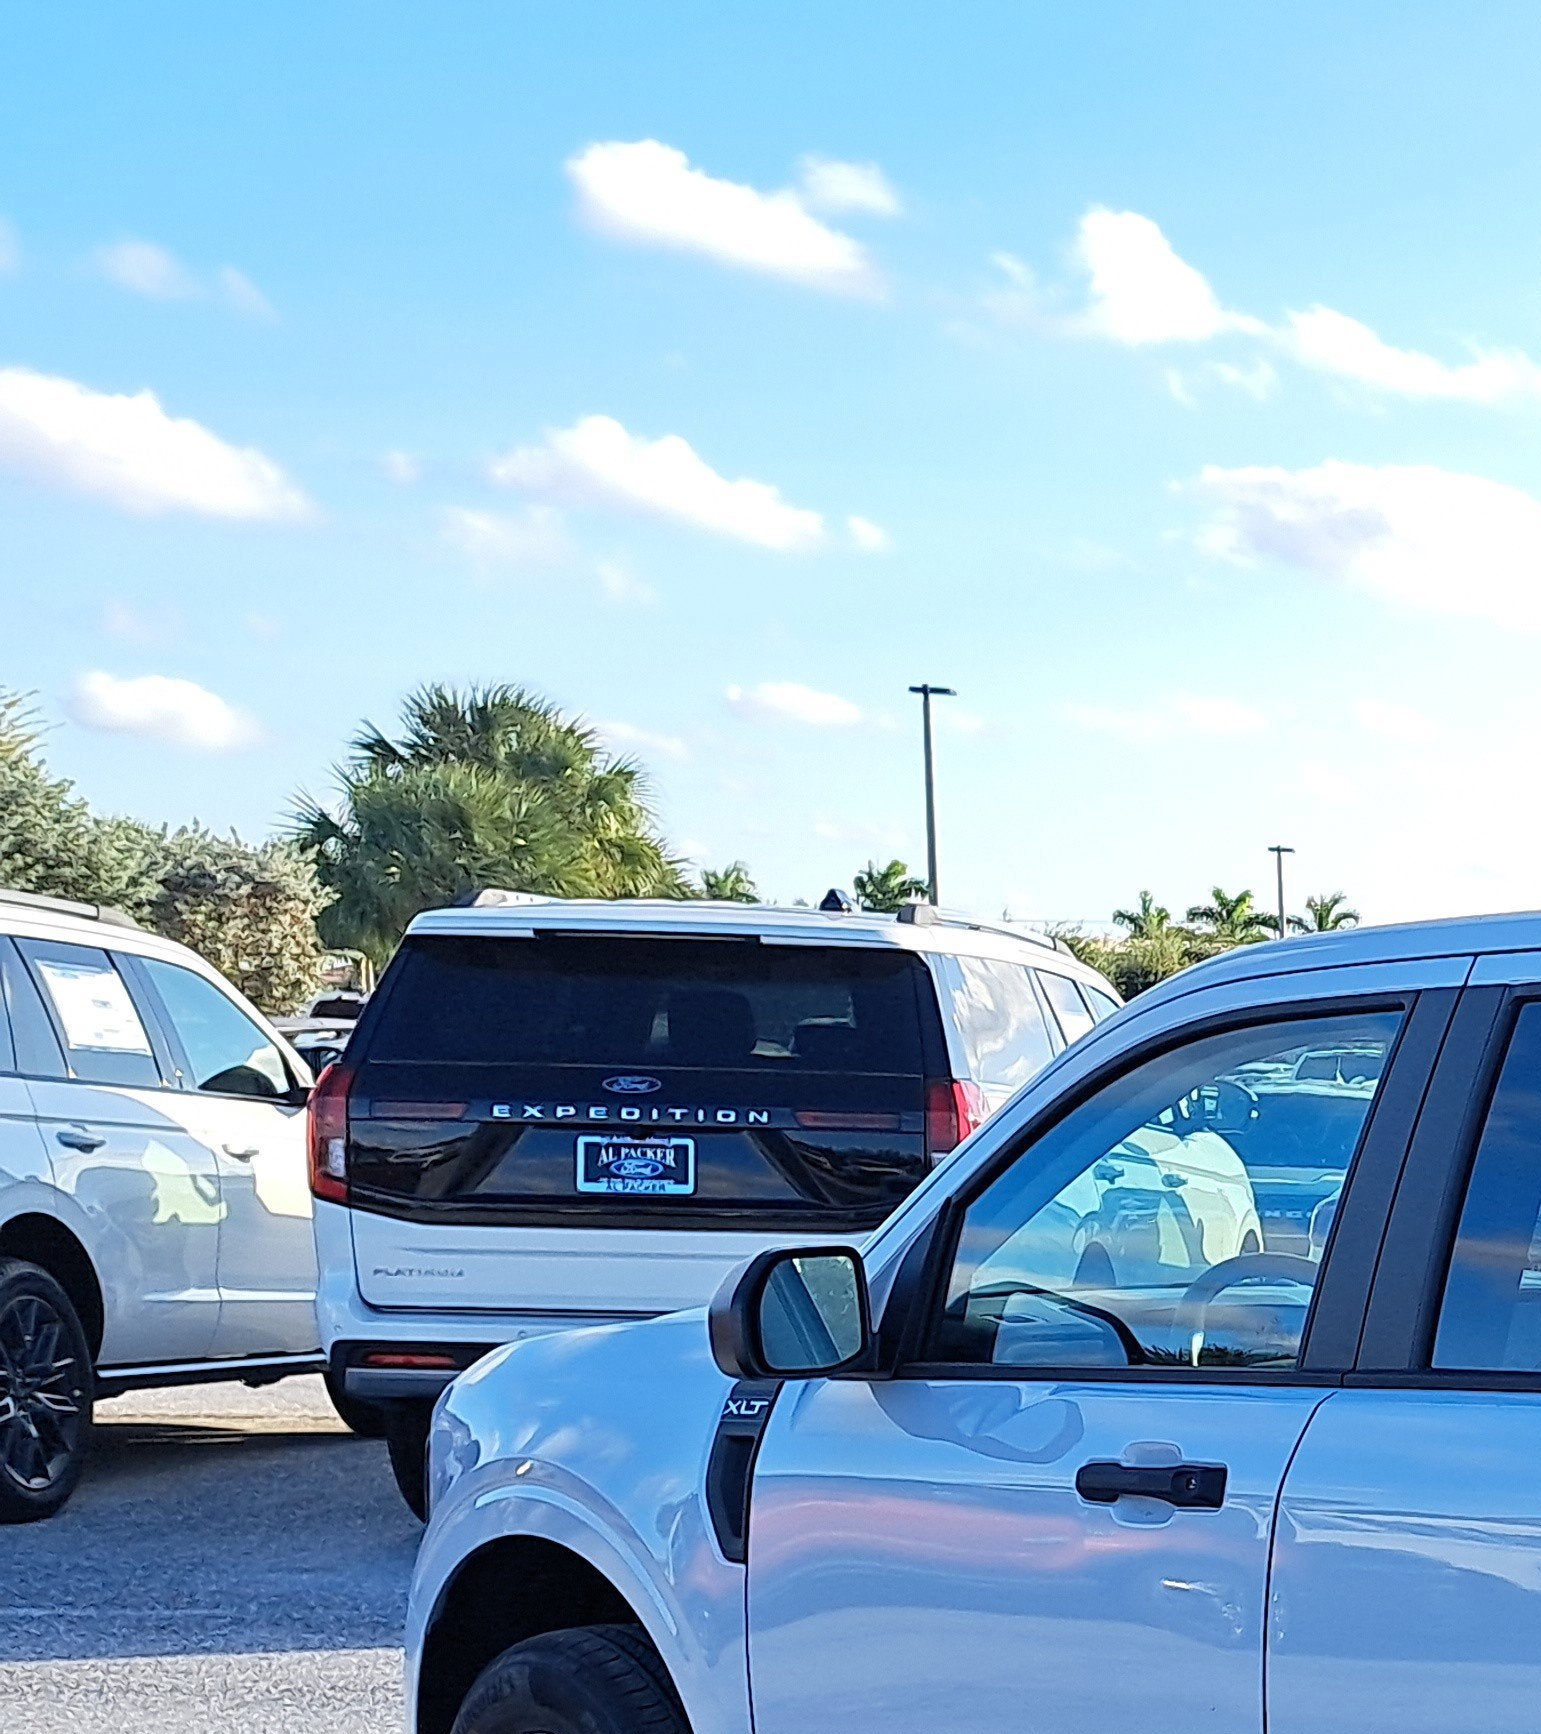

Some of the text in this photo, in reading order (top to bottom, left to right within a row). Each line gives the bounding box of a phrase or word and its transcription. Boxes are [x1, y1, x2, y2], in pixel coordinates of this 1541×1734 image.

[491, 1103, 769, 1124] EXPEDITION
[597, 1146, 677, 1168] AL PACKER
[722, 1400, 769, 1415] XLT
